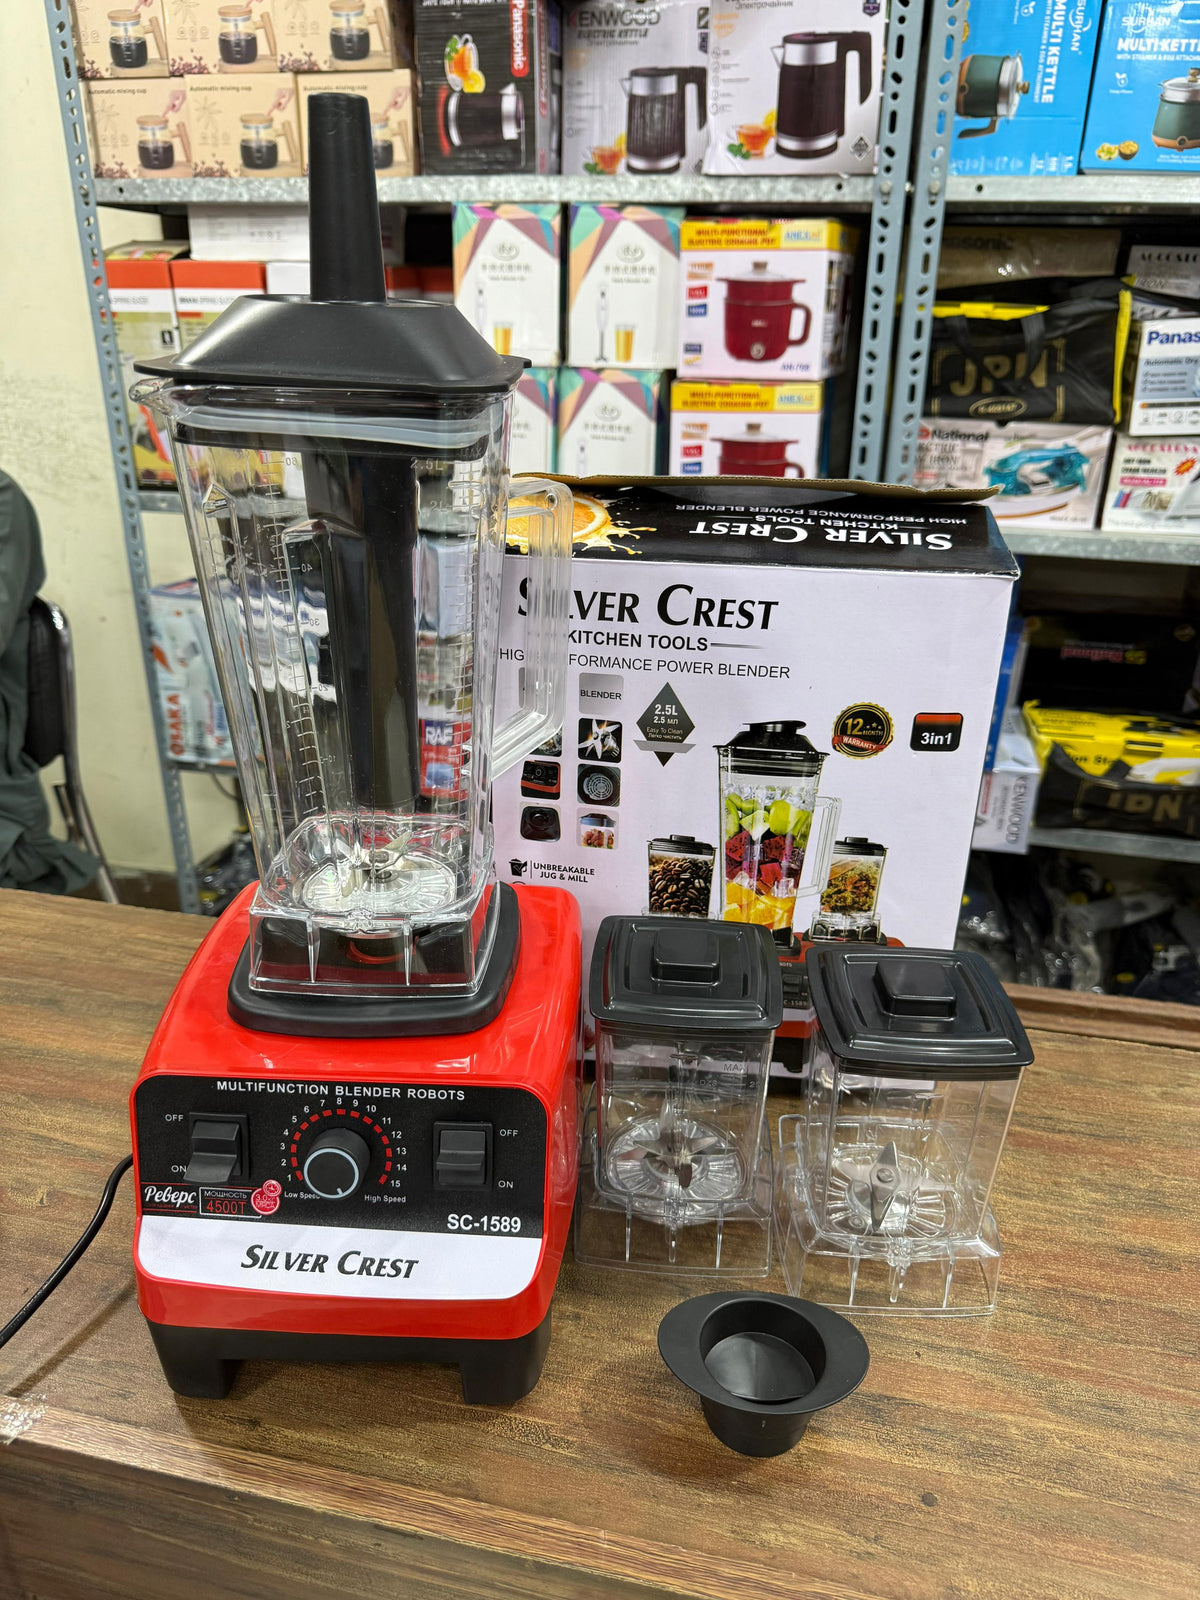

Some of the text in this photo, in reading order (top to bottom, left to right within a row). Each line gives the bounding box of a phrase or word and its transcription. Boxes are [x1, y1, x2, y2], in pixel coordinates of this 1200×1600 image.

[567, 9, 661, 27] KENWOOD
[1117, 37, 1157, 52] MULTI
[1041, 0, 1067, 103] MULTI KETTLE
[931, 429, 990, 442] National
[410, 456, 444, 471] 2.5L
[675, 504, 967, 526] HIGH PERFORMANCE POWER BLENDER
[754, 514, 899, 530] KITCHEN TOOLS
[688, 521, 954, 551] SILVER CREST
[517, 577, 780, 631] SVER CREST
[568, 629, 709, 651] KITCHEN TOOLS
[499, 648, 791, 679] HIG FORMANCE POWER BLENDER
[579, 689, 622, 701] BLENDER
[654, 703, 678, 716] 2.5L
[653, 715, 666, 724] 2.5
[646, 726, 660, 734] Easy
[667, 728, 684, 736] Clean
[844, 717, 863, 736] 12
[842, 735, 878, 751] WARRANTY
[920, 731, 953, 745] 3in1
[533, 862, 595, 876] UNBREAKABLE
[540, 871, 589, 883] JUG & MILL
[216, 1080, 465, 1101] MULTIFUNCTION BLENDER ROBOTS
[319, 1099, 325, 1107] 7
[336, 1097, 342, 1105] 8
[352, 1099, 359, 1107] 9
[365, 1105, 377, 1113] 10
[164, 1113, 184, 1122] OFF
[291, 1115, 298, 1123] 5
[381, 1117, 391, 1125] 11
[283, 1128, 289, 1136] 4
[391, 1131, 402, 1139] 12
[499, 1128, 519, 1137] OFF
[280, 1142, 286, 1150] 3
[396, 1147, 407, 1155] 13
[171, 1164, 187, 1173] ON
[396, 1164, 407, 1172] 14
[390, 1180, 401, 1188] 15
[498, 1180, 514, 1189] ON
[144, 1185, 197, 1208] Реверс
[203, 1190, 247, 1199] МОЩНОСТЬ
[284, 1191, 298, 1199] Low
[364, 1194, 407, 1204] High Speed
[447, 1213, 522, 1233] SC-1589
[240, 1244, 420, 1279] SILVER CREST
